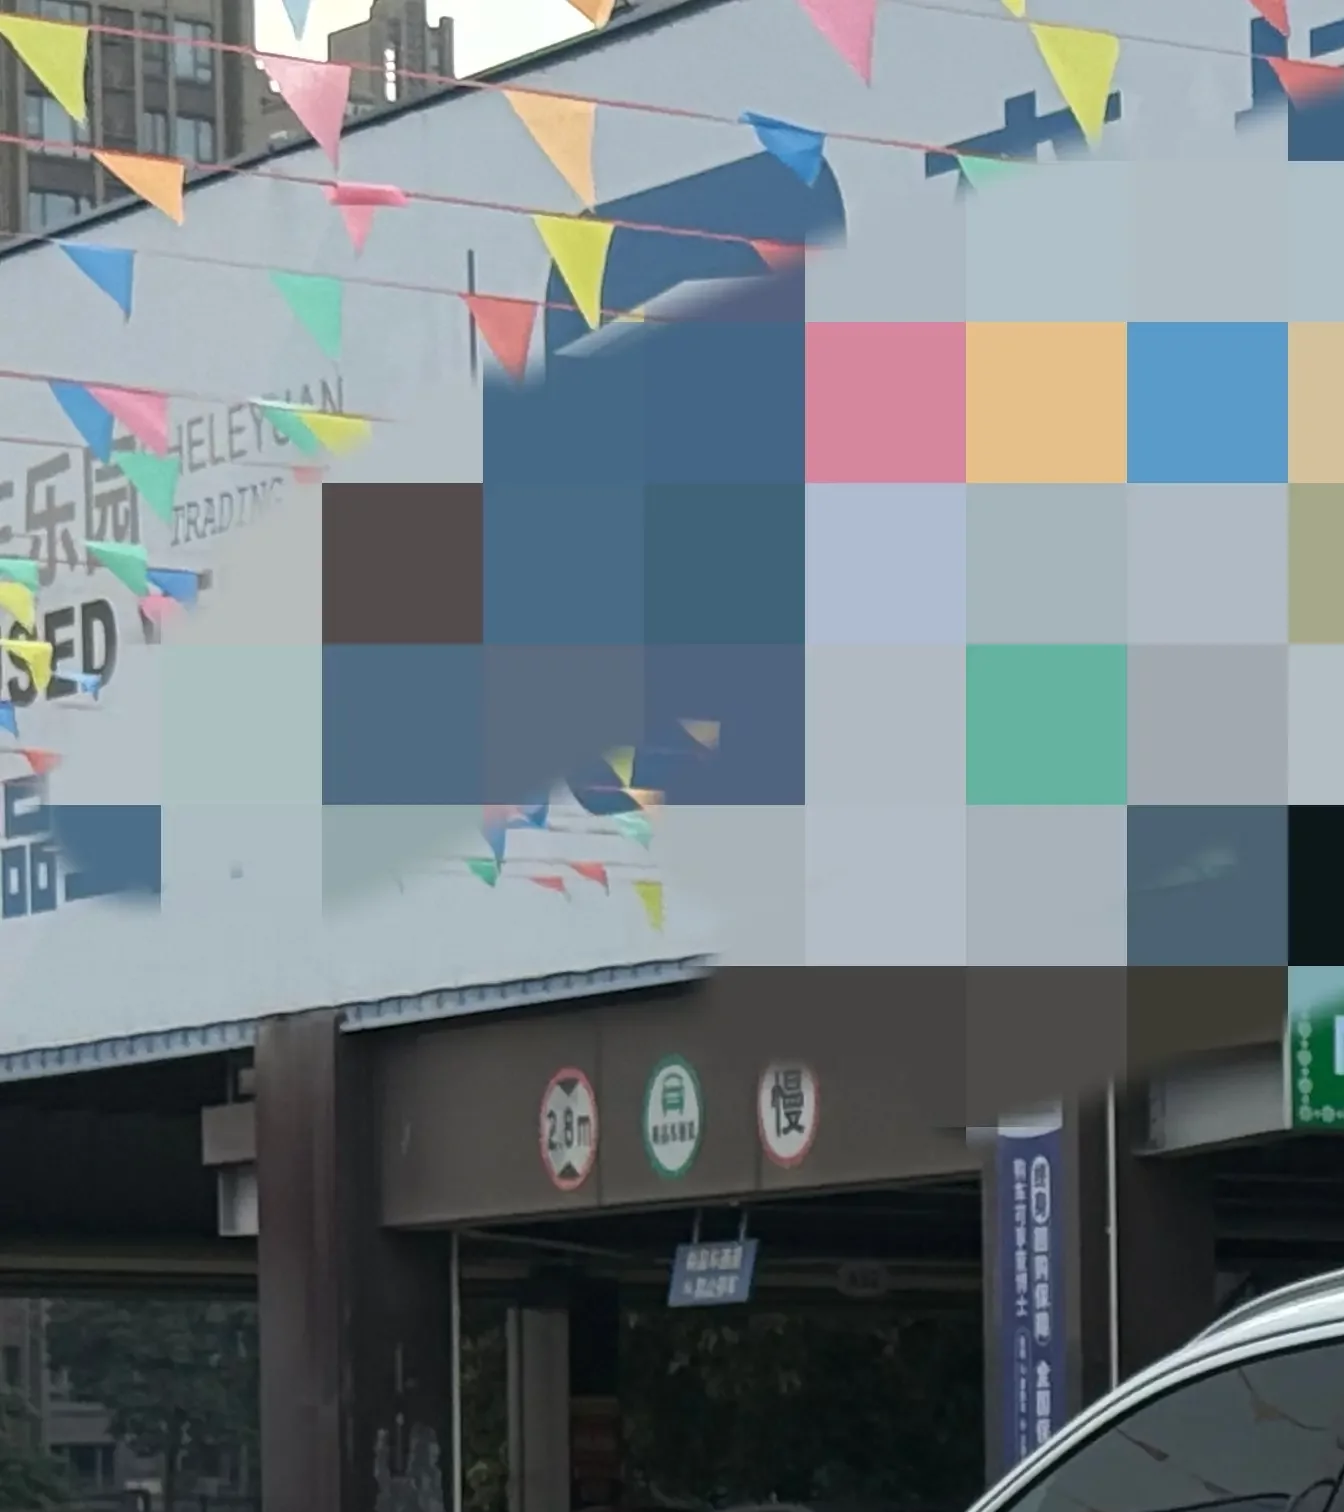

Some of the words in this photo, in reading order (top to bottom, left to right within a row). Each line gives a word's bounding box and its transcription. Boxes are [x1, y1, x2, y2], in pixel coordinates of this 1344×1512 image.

[0, 434, 141, 588] 乐园
[0, 598, 118, 708] SED
[770, 1068, 805, 1138] 慢
